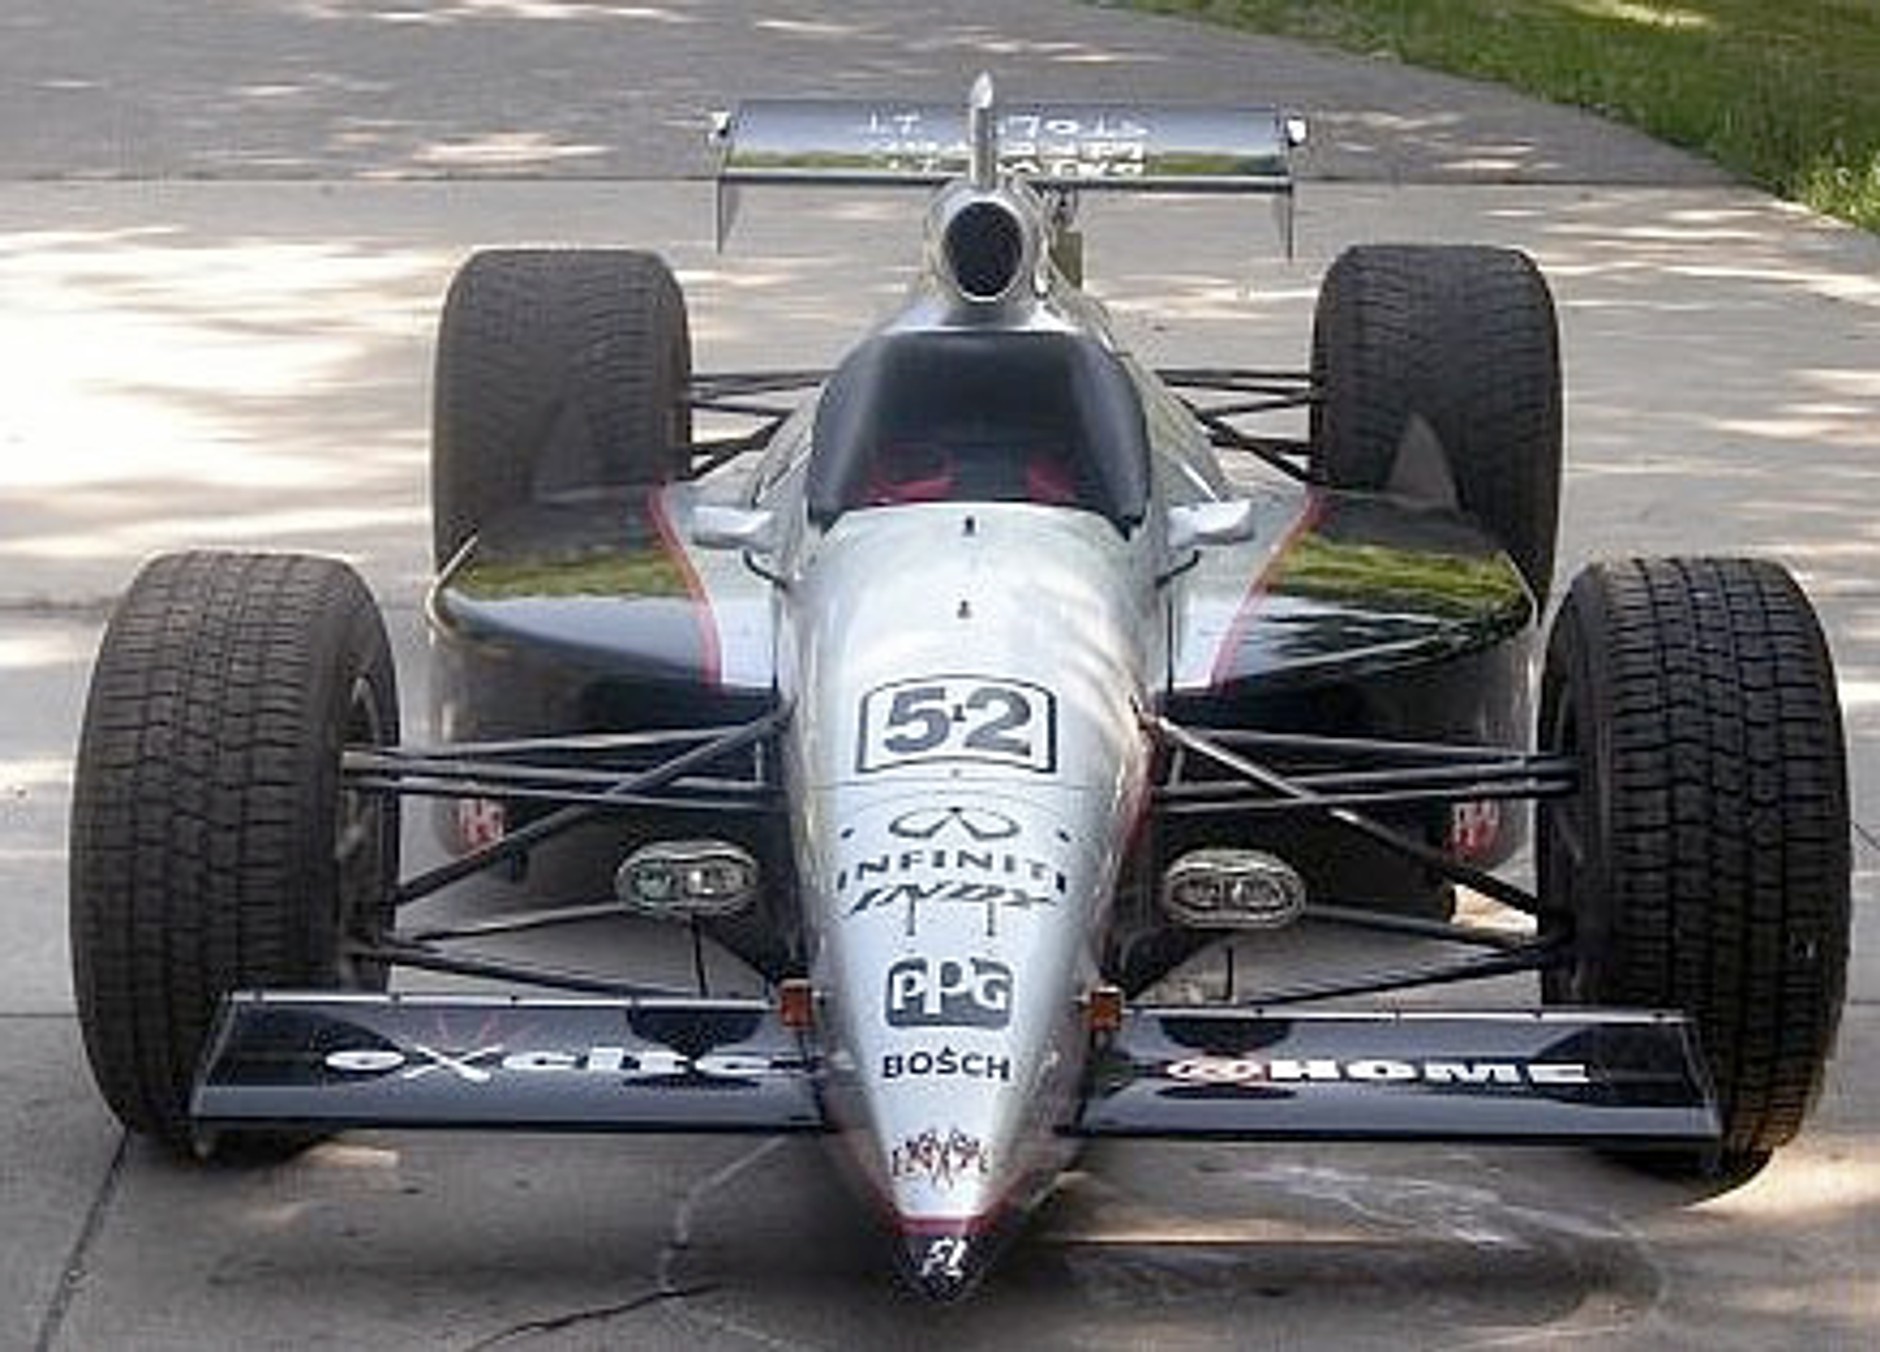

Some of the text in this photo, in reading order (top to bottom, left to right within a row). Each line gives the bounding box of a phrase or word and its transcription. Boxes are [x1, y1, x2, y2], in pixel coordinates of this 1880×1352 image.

[884, 687, 1031, 756] 52
[889, 958, 1010, 1018] PPG
[882, 1048, 1011, 1081] BOSCH
